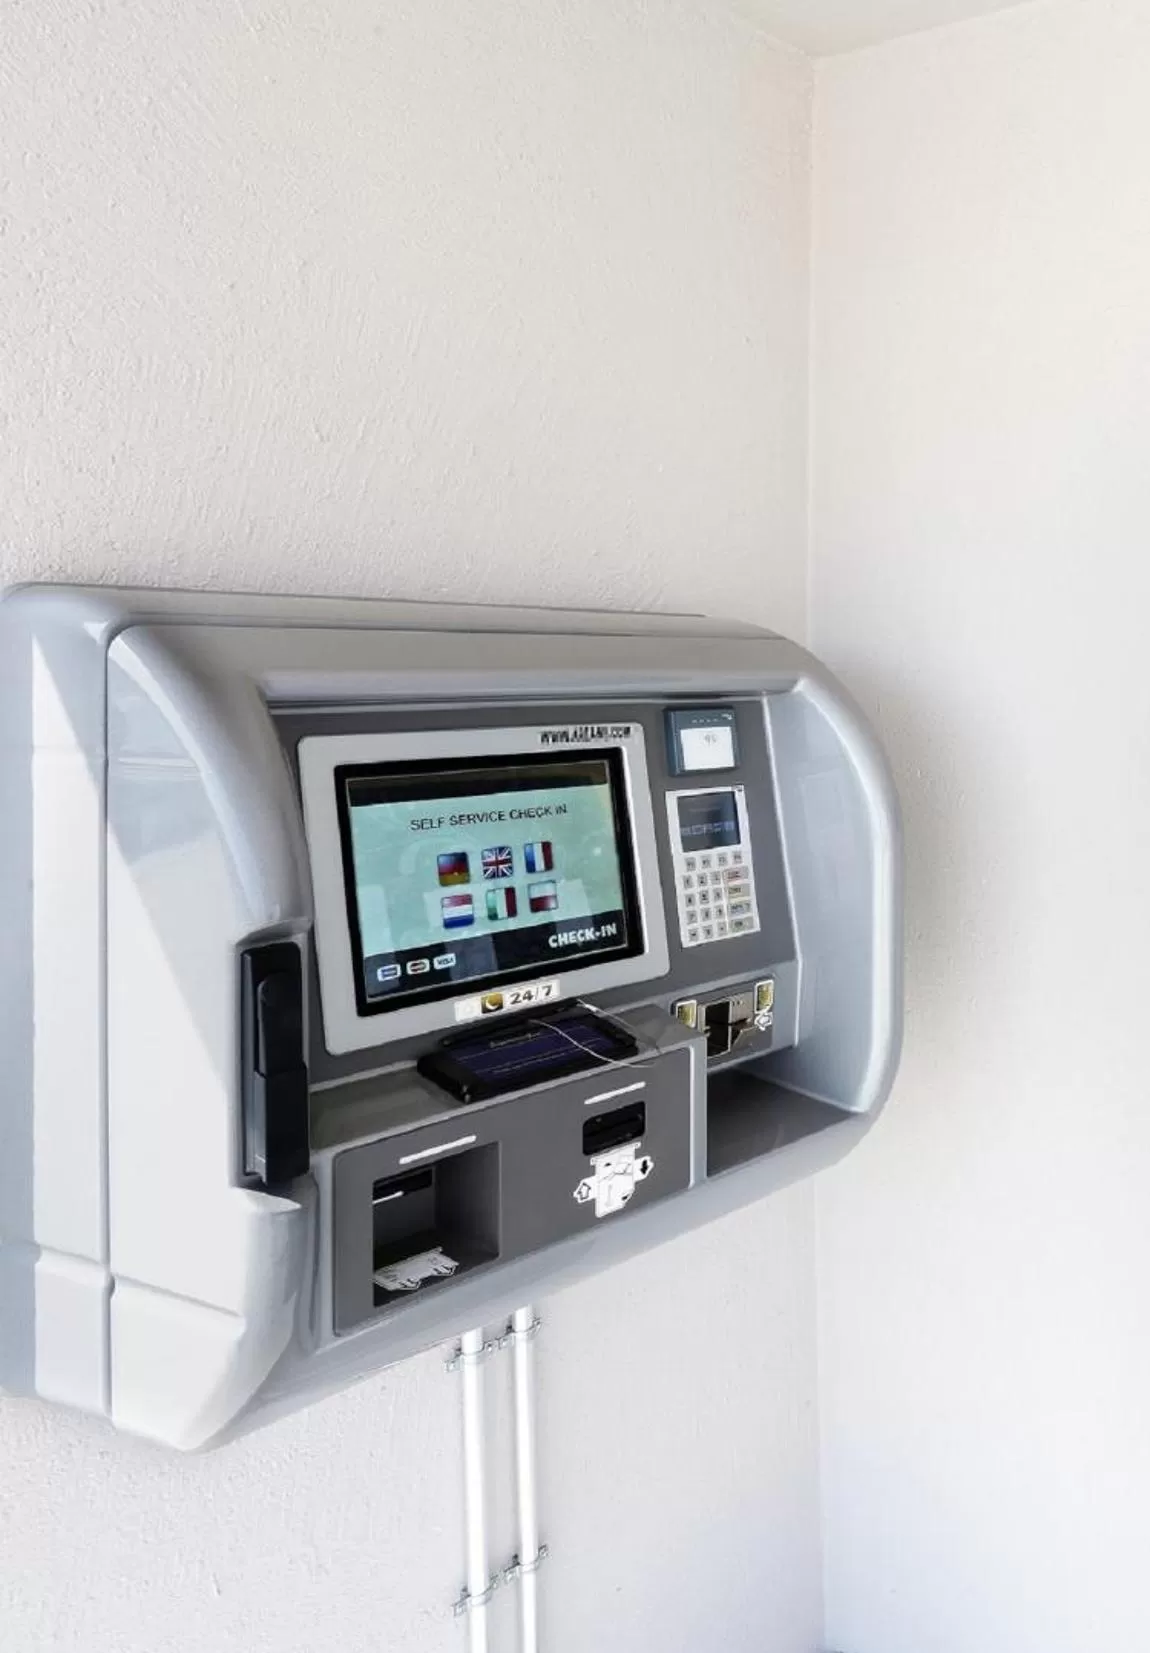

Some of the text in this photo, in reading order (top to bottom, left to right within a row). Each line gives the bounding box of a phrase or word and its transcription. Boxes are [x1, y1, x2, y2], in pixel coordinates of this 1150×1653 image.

[410, 803, 568, 831] SELF SERVICE CHECK IN
[548, 922, 617, 949] CHECK-IN
[509, 984, 553, 1005] 24/7
